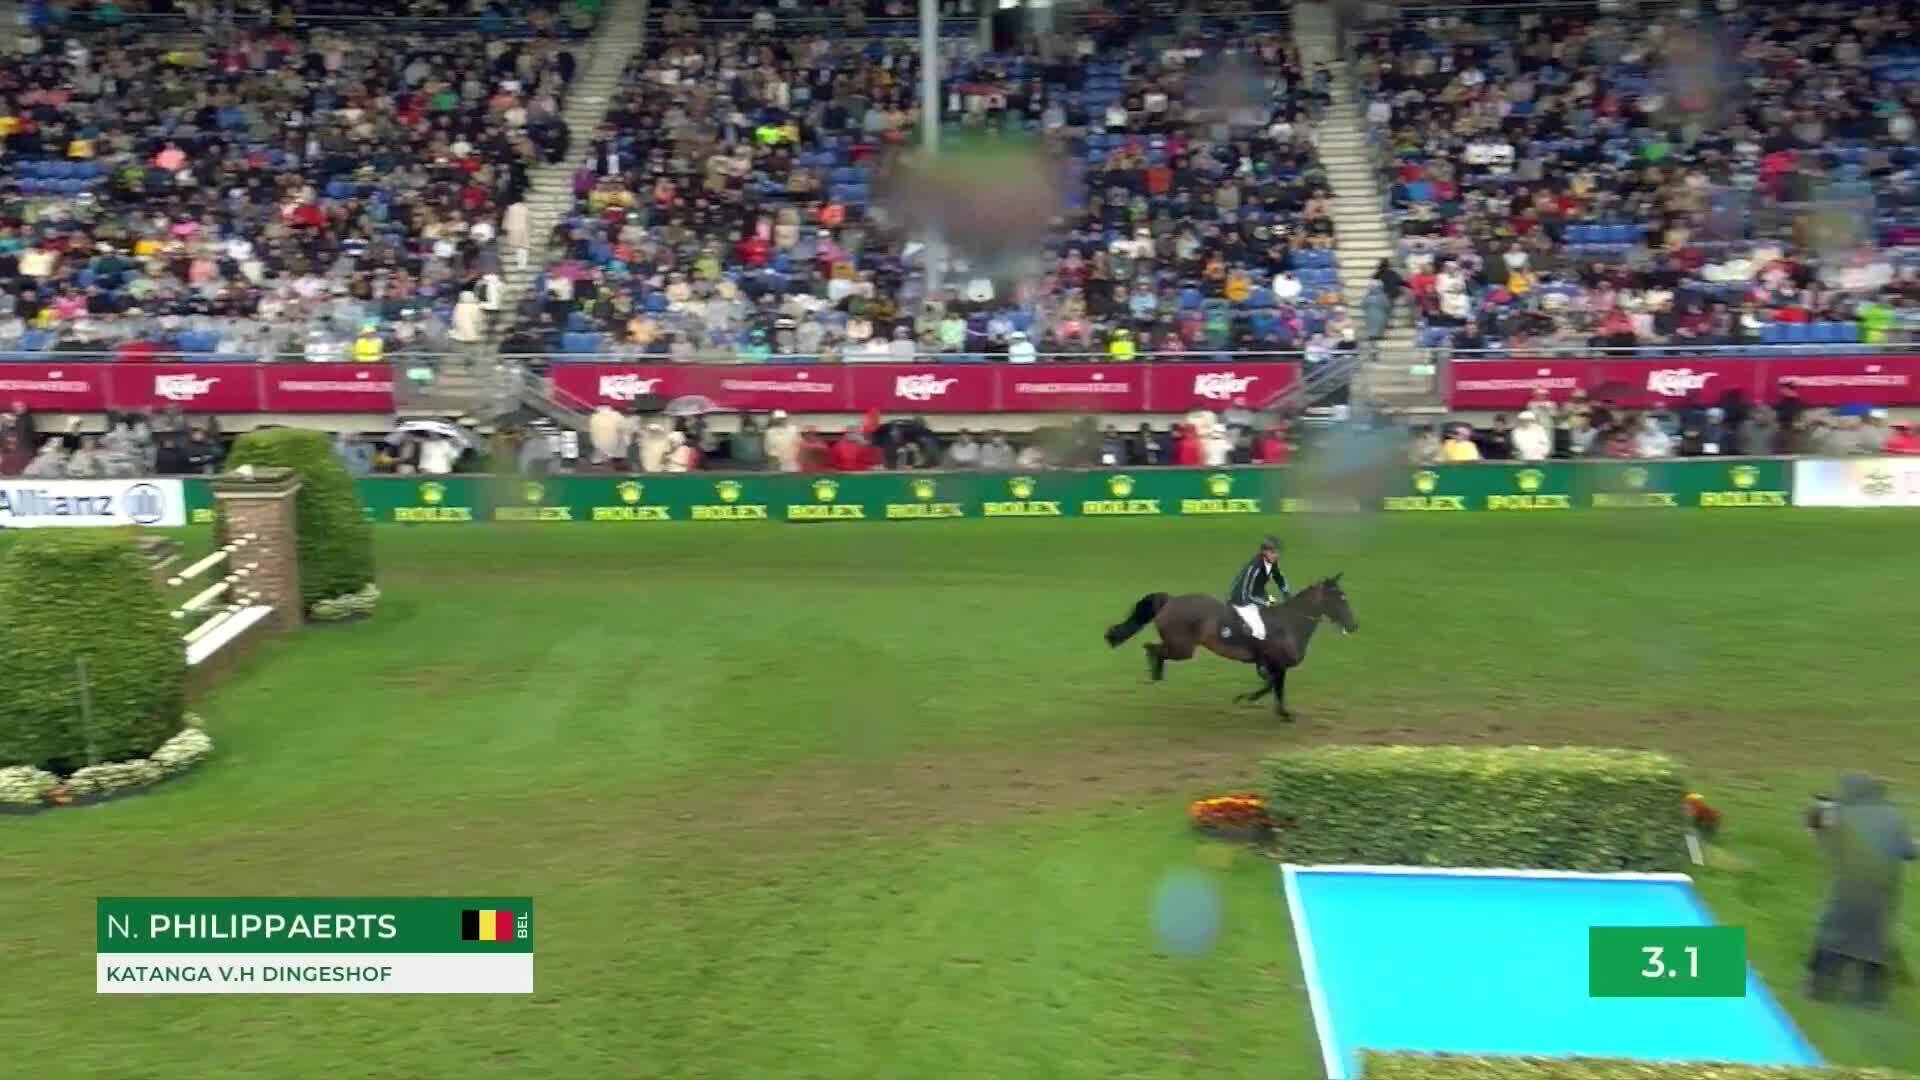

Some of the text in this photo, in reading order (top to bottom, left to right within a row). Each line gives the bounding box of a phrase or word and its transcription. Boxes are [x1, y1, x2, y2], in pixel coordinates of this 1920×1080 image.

[1181, 499, 1260, 513] ROLEX
[1384, 496, 1466, 511] ROLEX
[1487, 495, 1570, 510] ROLEX
[1700, 491, 1788, 506] ROLEX
[394, 507, 472, 521] ROLEX
[592, 506, 671, 521] ROLEX
[691, 505, 767, 520] ROLEX
[787, 504, 864, 519] ROLEX
[886, 503, 964, 518] ROLEX
[984, 502, 1062, 517] ROLEX
[1082, 500, 1160, 514] ROLEX
